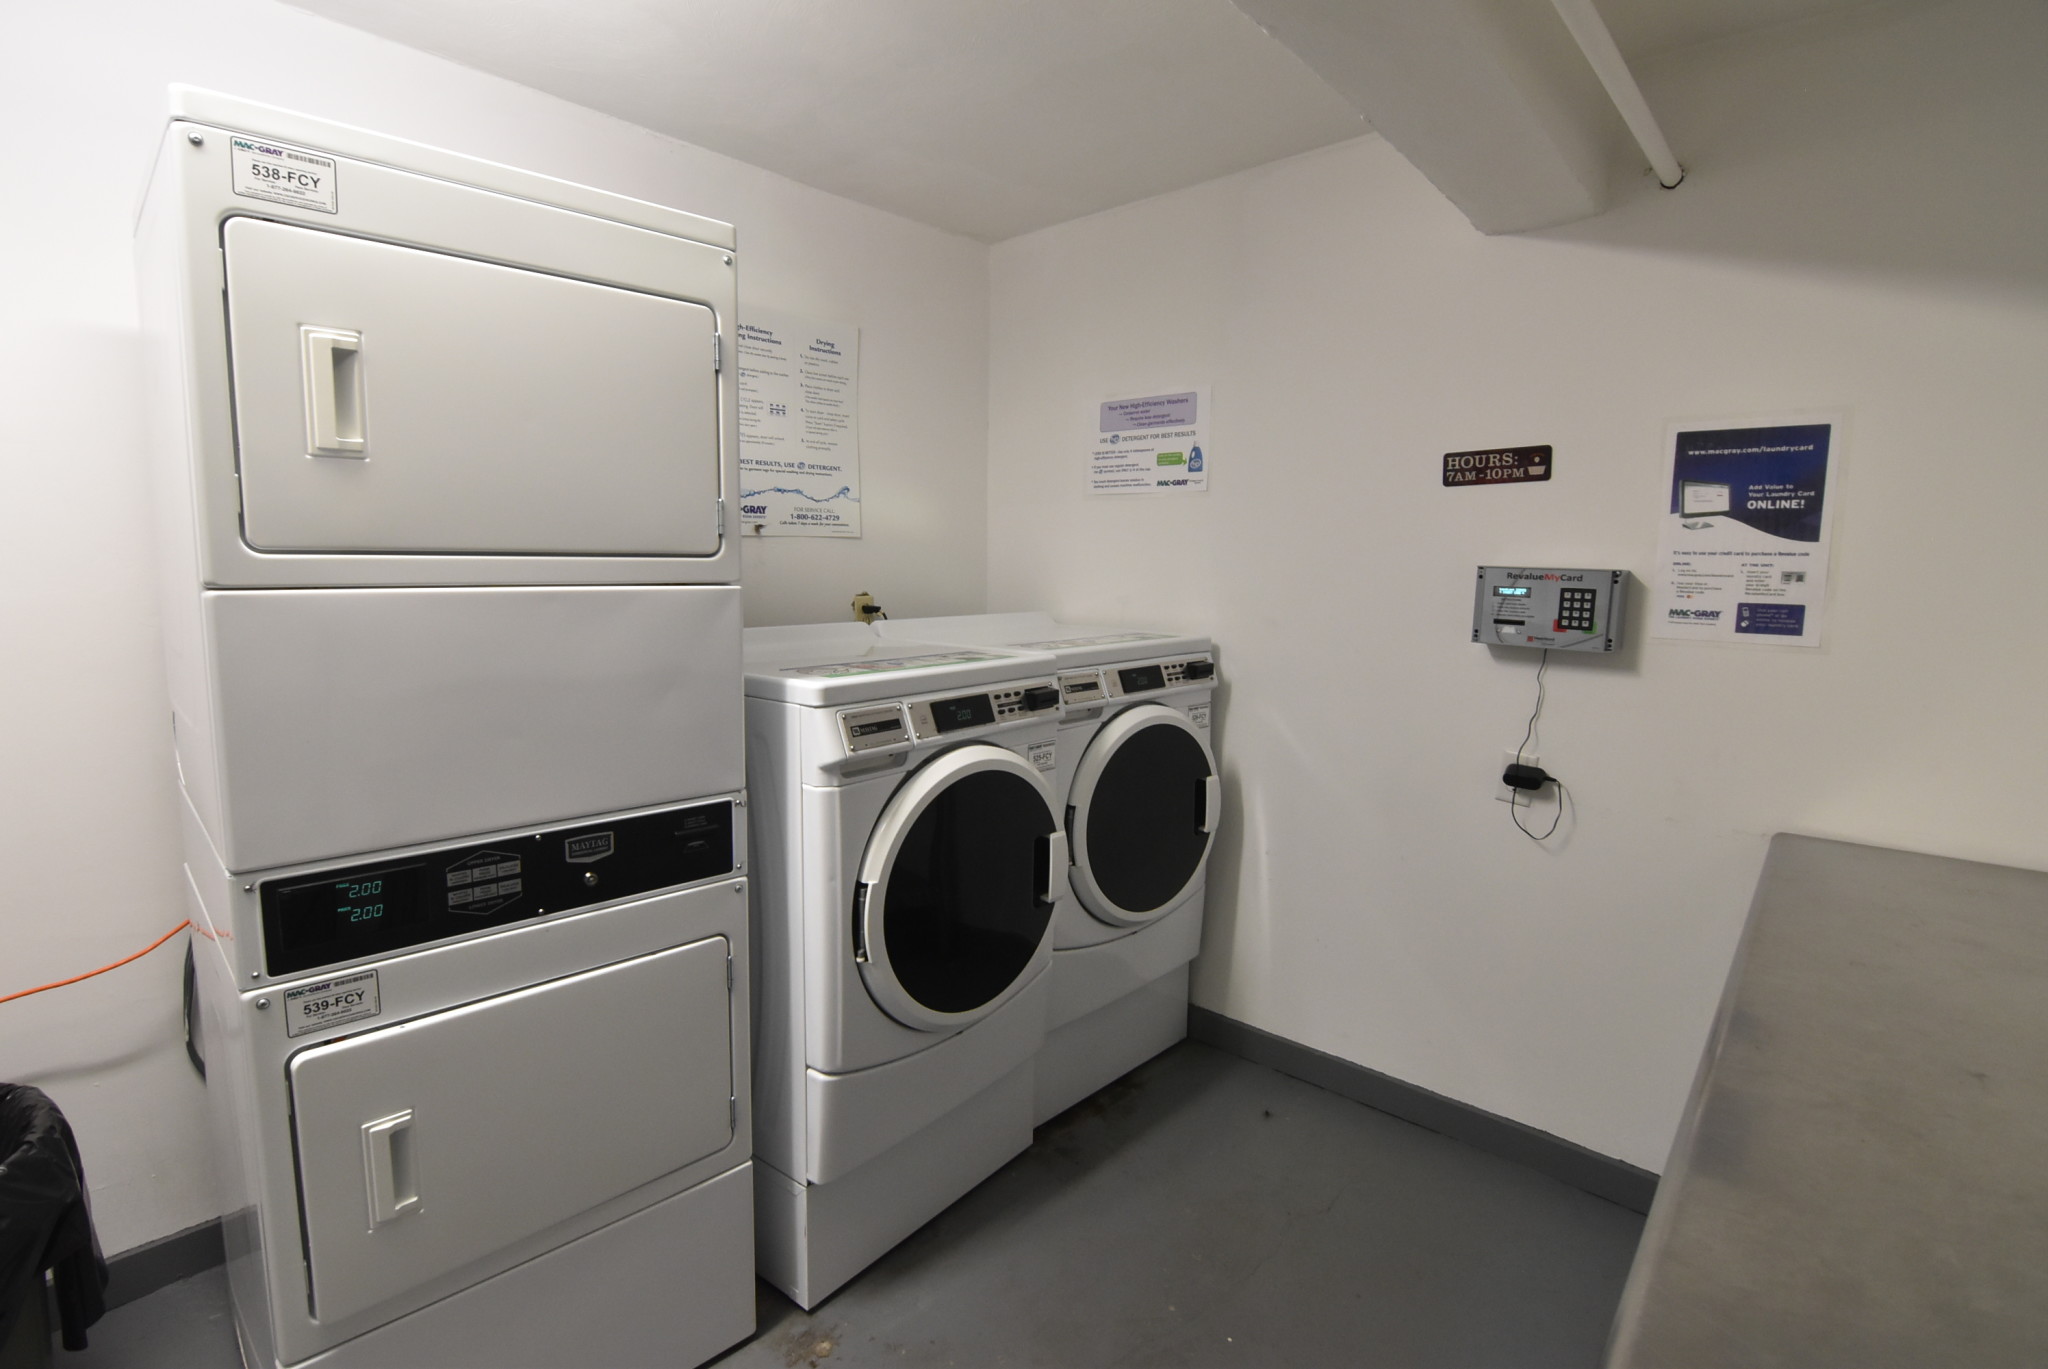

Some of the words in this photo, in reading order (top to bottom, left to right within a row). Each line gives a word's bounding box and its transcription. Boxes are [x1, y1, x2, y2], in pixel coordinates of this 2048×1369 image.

[252, 164, 321, 189] 538-FCY
[747, 334, 782, 346] Instructions
[816, 339, 836, 349] Drying
[809, 345, 842, 356] Instructions
[1122, 434, 1149, 442] DETERGENT
[1150, 432, 1160, 440] FOR
[1174, 430, 1197, 438] RESULTS
[1688, 444, 1814, 456] www.macgray.com/laundrycard
[755, 460, 783, 468] RESULTS,
[1446, 452, 1519, 470] HOURS:
[1156, 479, 1189, 487] MAC-GRAY
[1766, 490, 1795, 499] Laundry
[1746, 499, 1806, 510] ONLINE!
[790, 513, 840, 521] 1-800-622-4729
[1507, 572, 1584, 583] RevalueMyCard
[1668, 608, 1722, 619] MAC-GRAY
[571, 837, 609, 852] MAYTAG
[349, 880, 383, 898] 2.00
[350, 904, 384, 922] 2.00
[287, 983, 332, 999] MAC-GRAY
[303, 990, 365, 1015] 539-FCY
